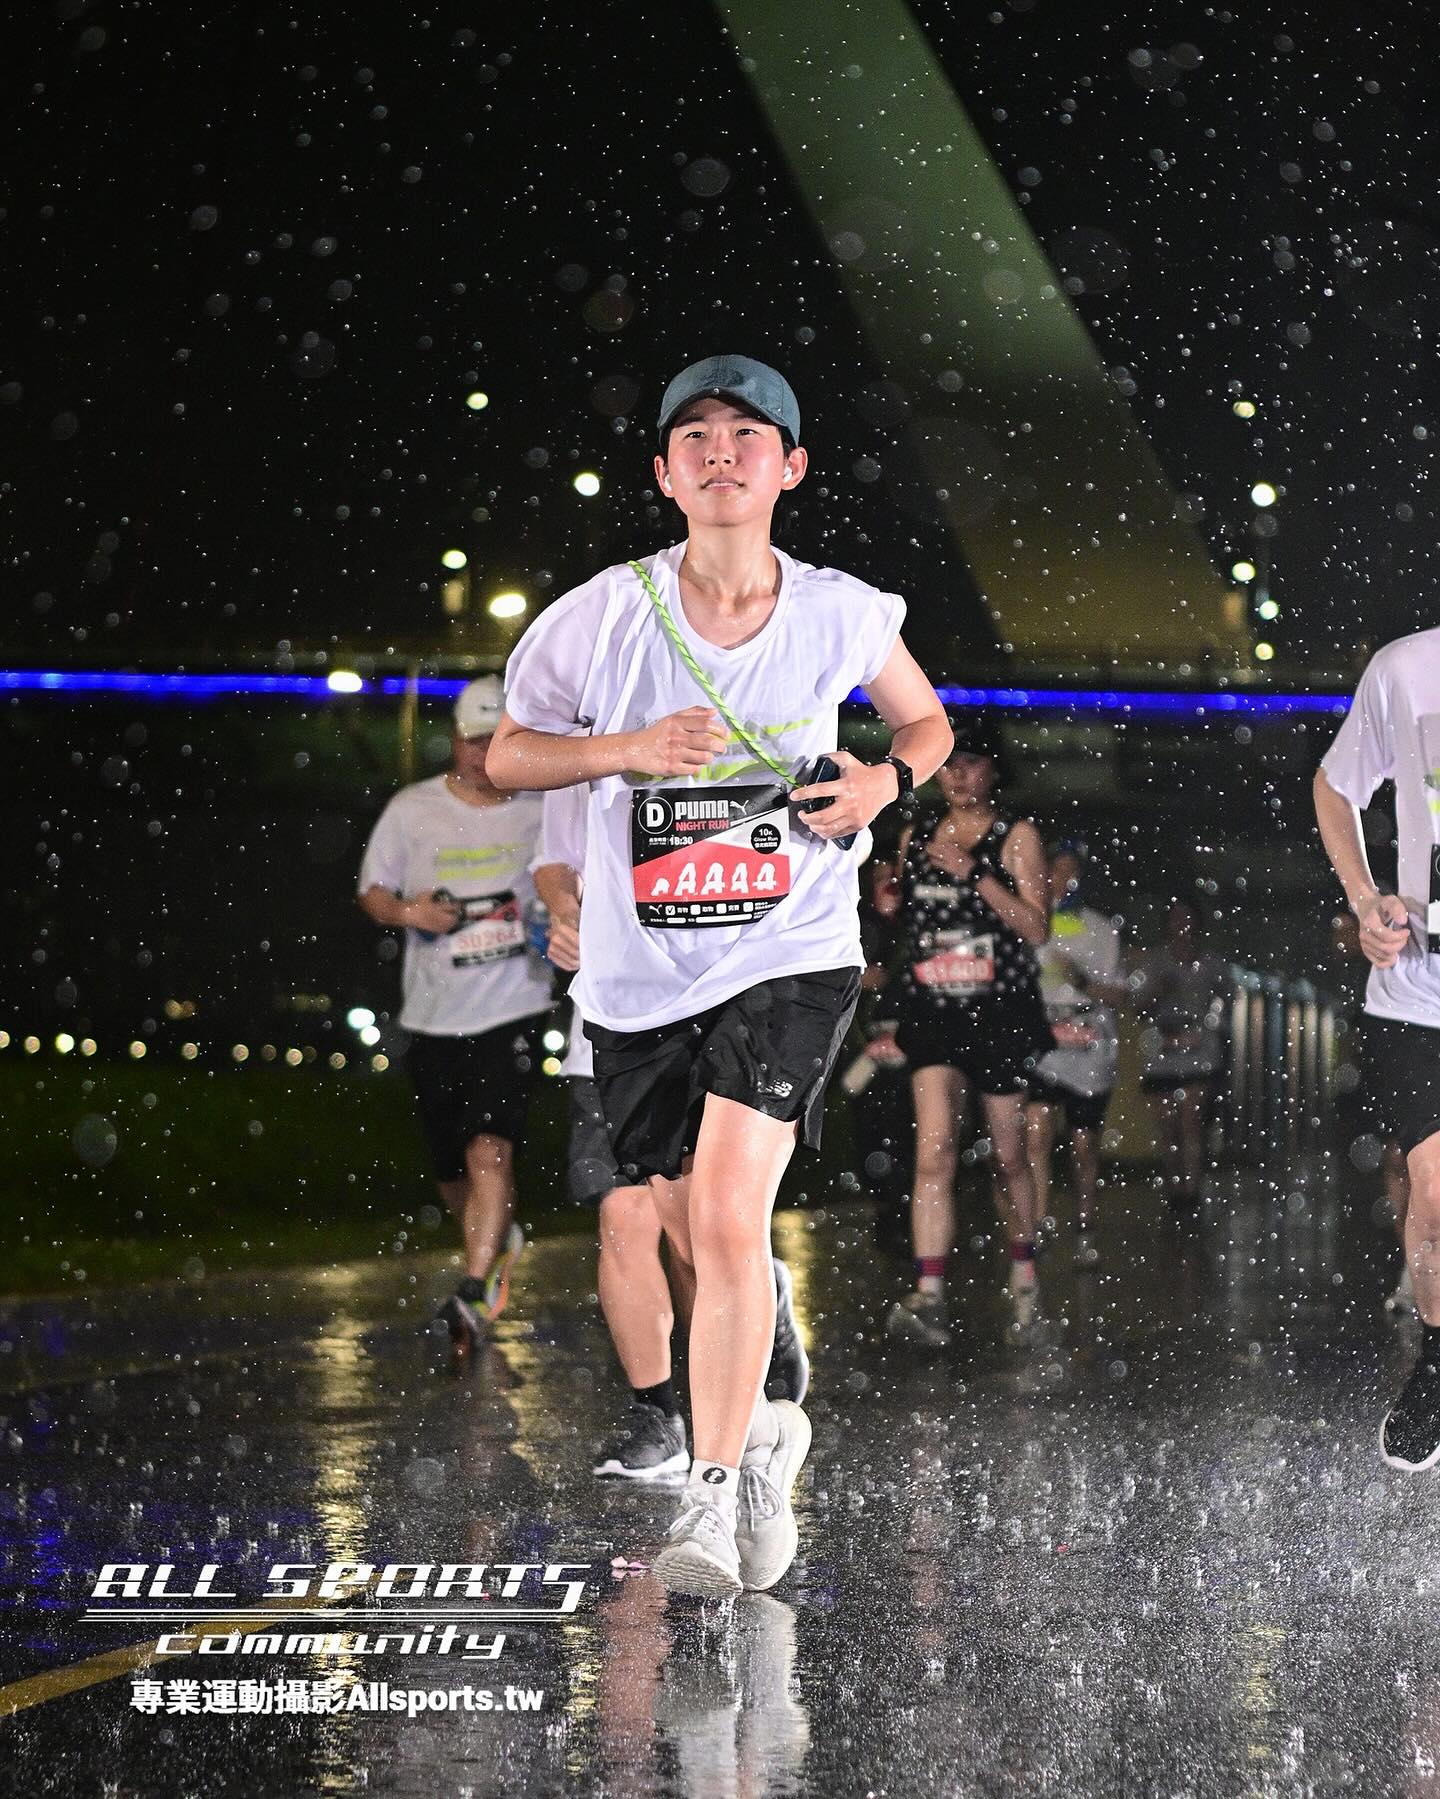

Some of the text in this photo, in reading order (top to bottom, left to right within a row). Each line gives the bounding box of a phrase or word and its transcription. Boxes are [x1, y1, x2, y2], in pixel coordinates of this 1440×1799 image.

[646, 802, 665, 828] D
[674, 799, 729, 821] PUMA
[675, 819, 731, 832] NIGHT RUN
[669, 835, 694, 846] 18:30
